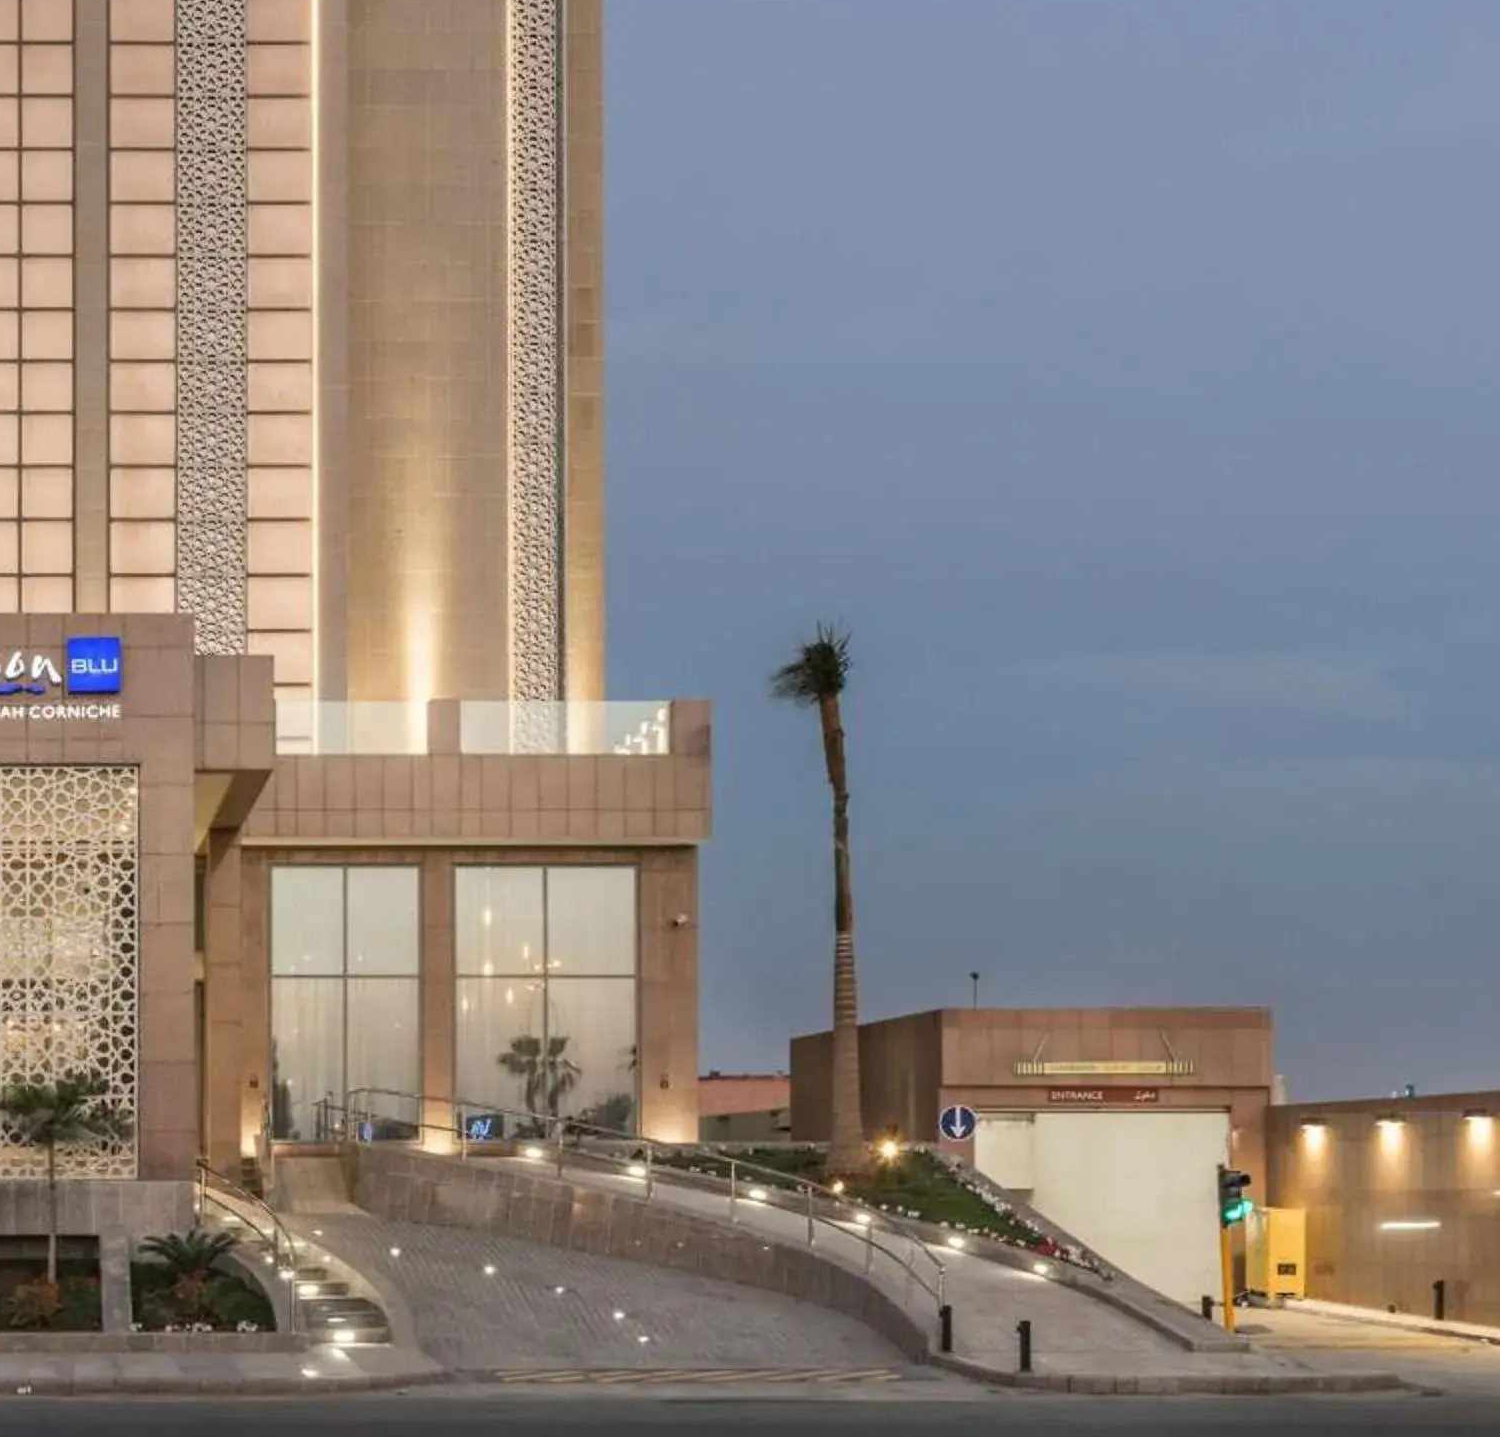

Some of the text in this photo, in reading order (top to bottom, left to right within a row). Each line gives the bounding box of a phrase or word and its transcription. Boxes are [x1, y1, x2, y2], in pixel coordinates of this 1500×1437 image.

[71, 658, 118, 674] BLU
[29, 704, 121, 720] CORNICHE
[1051, 1090, 1103, 1100] ENTRANCE
